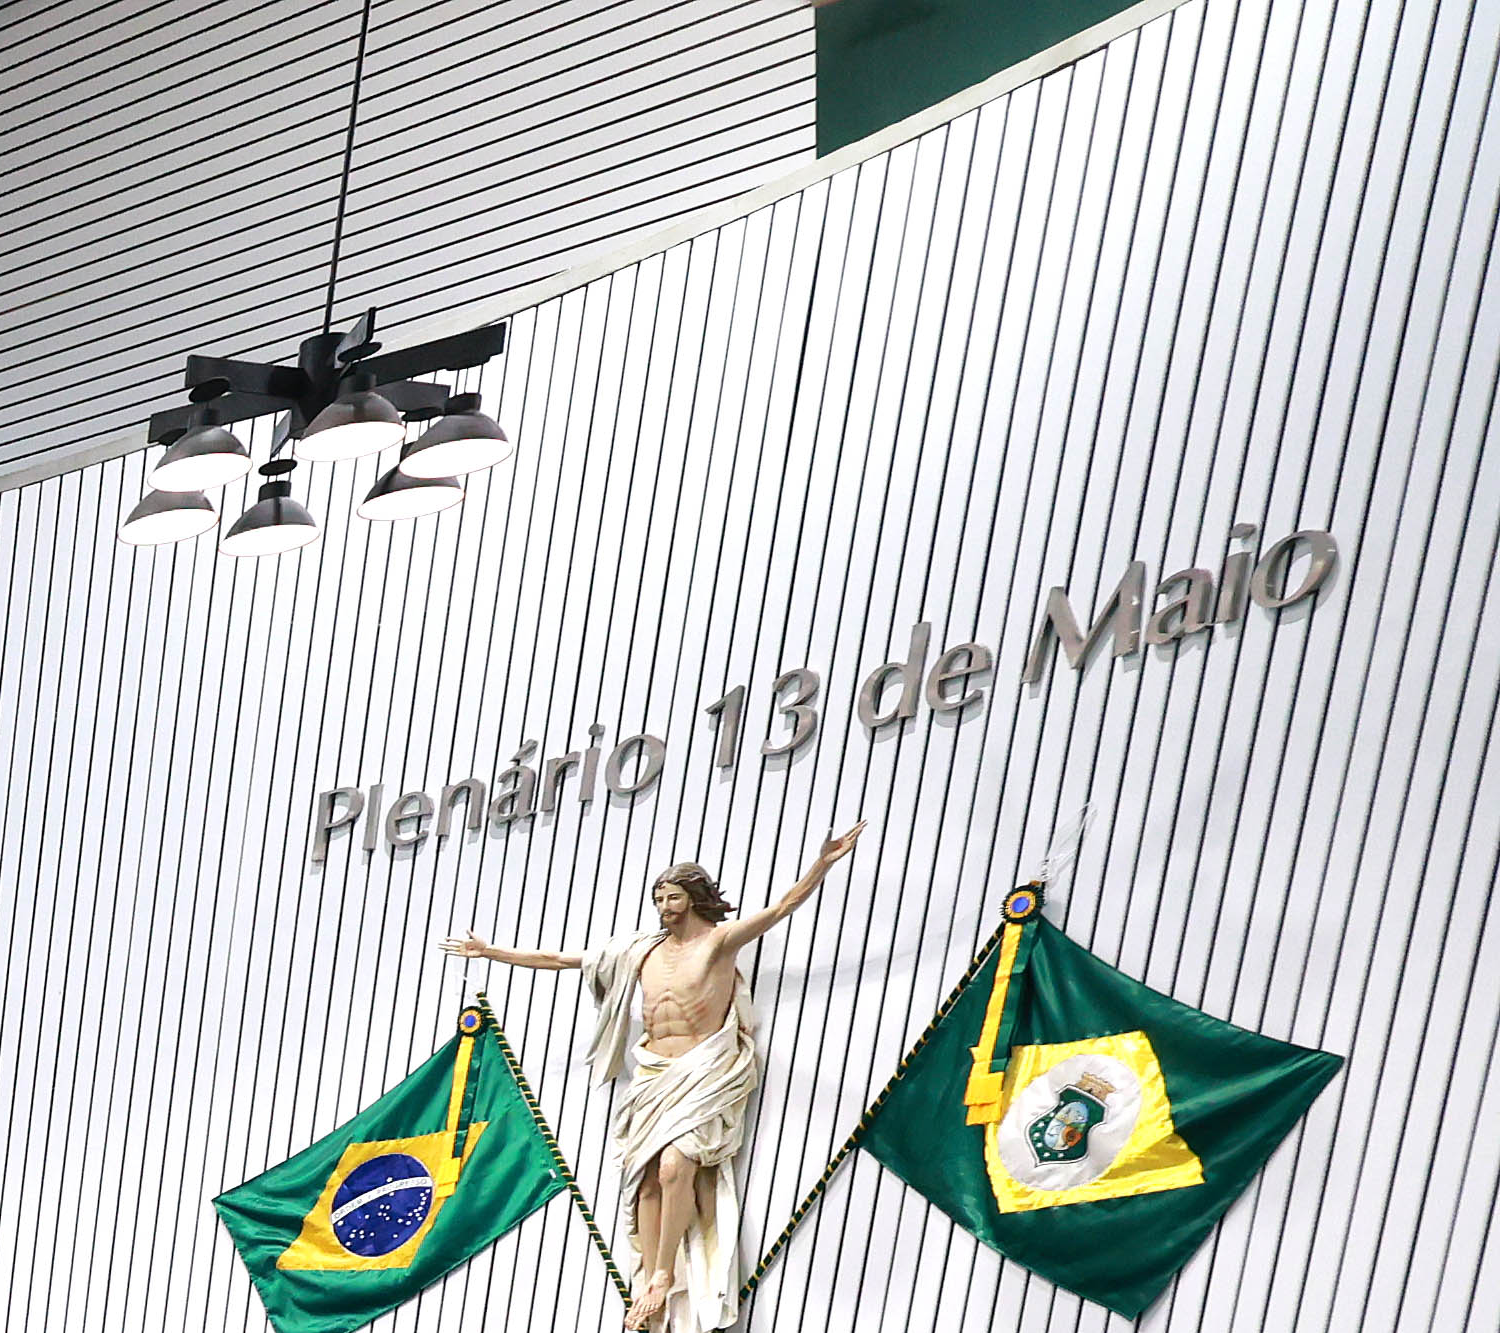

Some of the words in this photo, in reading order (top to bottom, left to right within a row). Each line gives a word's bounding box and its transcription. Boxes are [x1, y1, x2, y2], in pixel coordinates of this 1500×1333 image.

[313, 722, 666, 862] Plenário
[704, 668, 819, 768] 13
[858, 621, 993, 729] de
[1021, 522, 1338, 684] Maio
